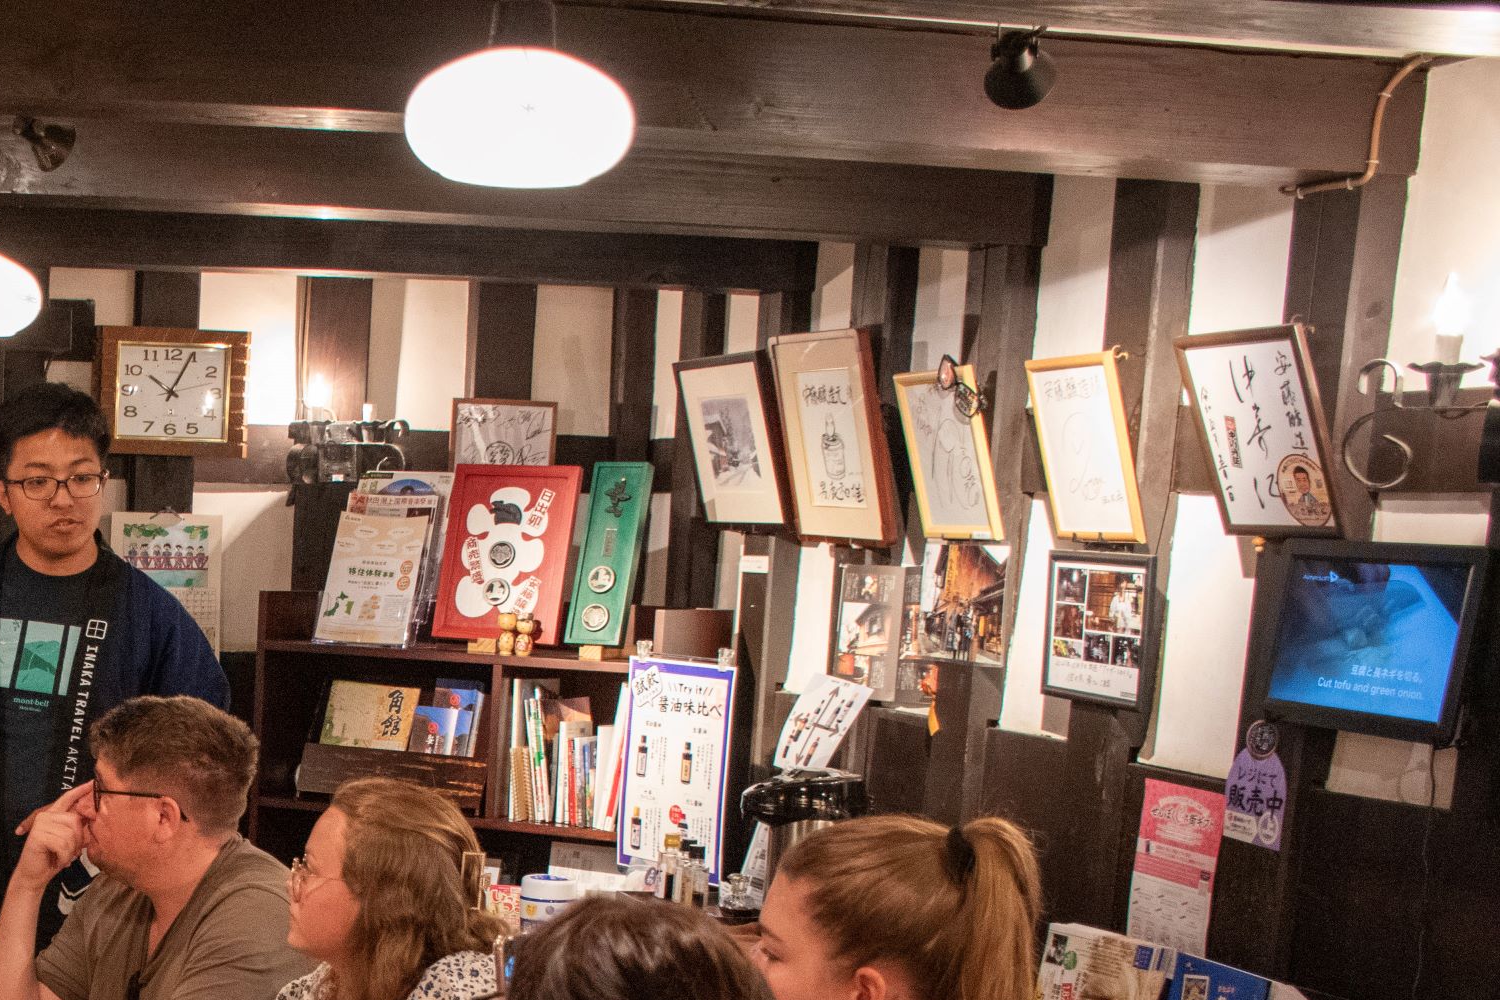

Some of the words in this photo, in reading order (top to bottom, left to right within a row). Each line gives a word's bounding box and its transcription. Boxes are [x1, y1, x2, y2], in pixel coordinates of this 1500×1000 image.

[144, 349, 158, 361] 11
[164, 348, 183, 360] 12
[124, 364, 143, 376] 10
[205, 366, 218, 378] 2
[121, 384, 135, 396] 9
[210, 388, 222, 400] 3
[124, 406, 138, 418] 8
[203, 409, 217, 420] 4
[143, 421, 154, 432] 7
[164, 424, 176, 436] 6
[186, 423, 198, 434] 5
[80, 645, 98, 686] INAKA
[1318, 677, 1332, 688] Cut
[1334, 678, 1350, 690] tofu
[1353, 682, 1369, 692] and
[1370, 685, 1396, 696] green
[70, 691, 90, 742] TRAVEL
[61, 745, 80, 790] AKITA
[1227, 784, 1283, 820] 販売中
